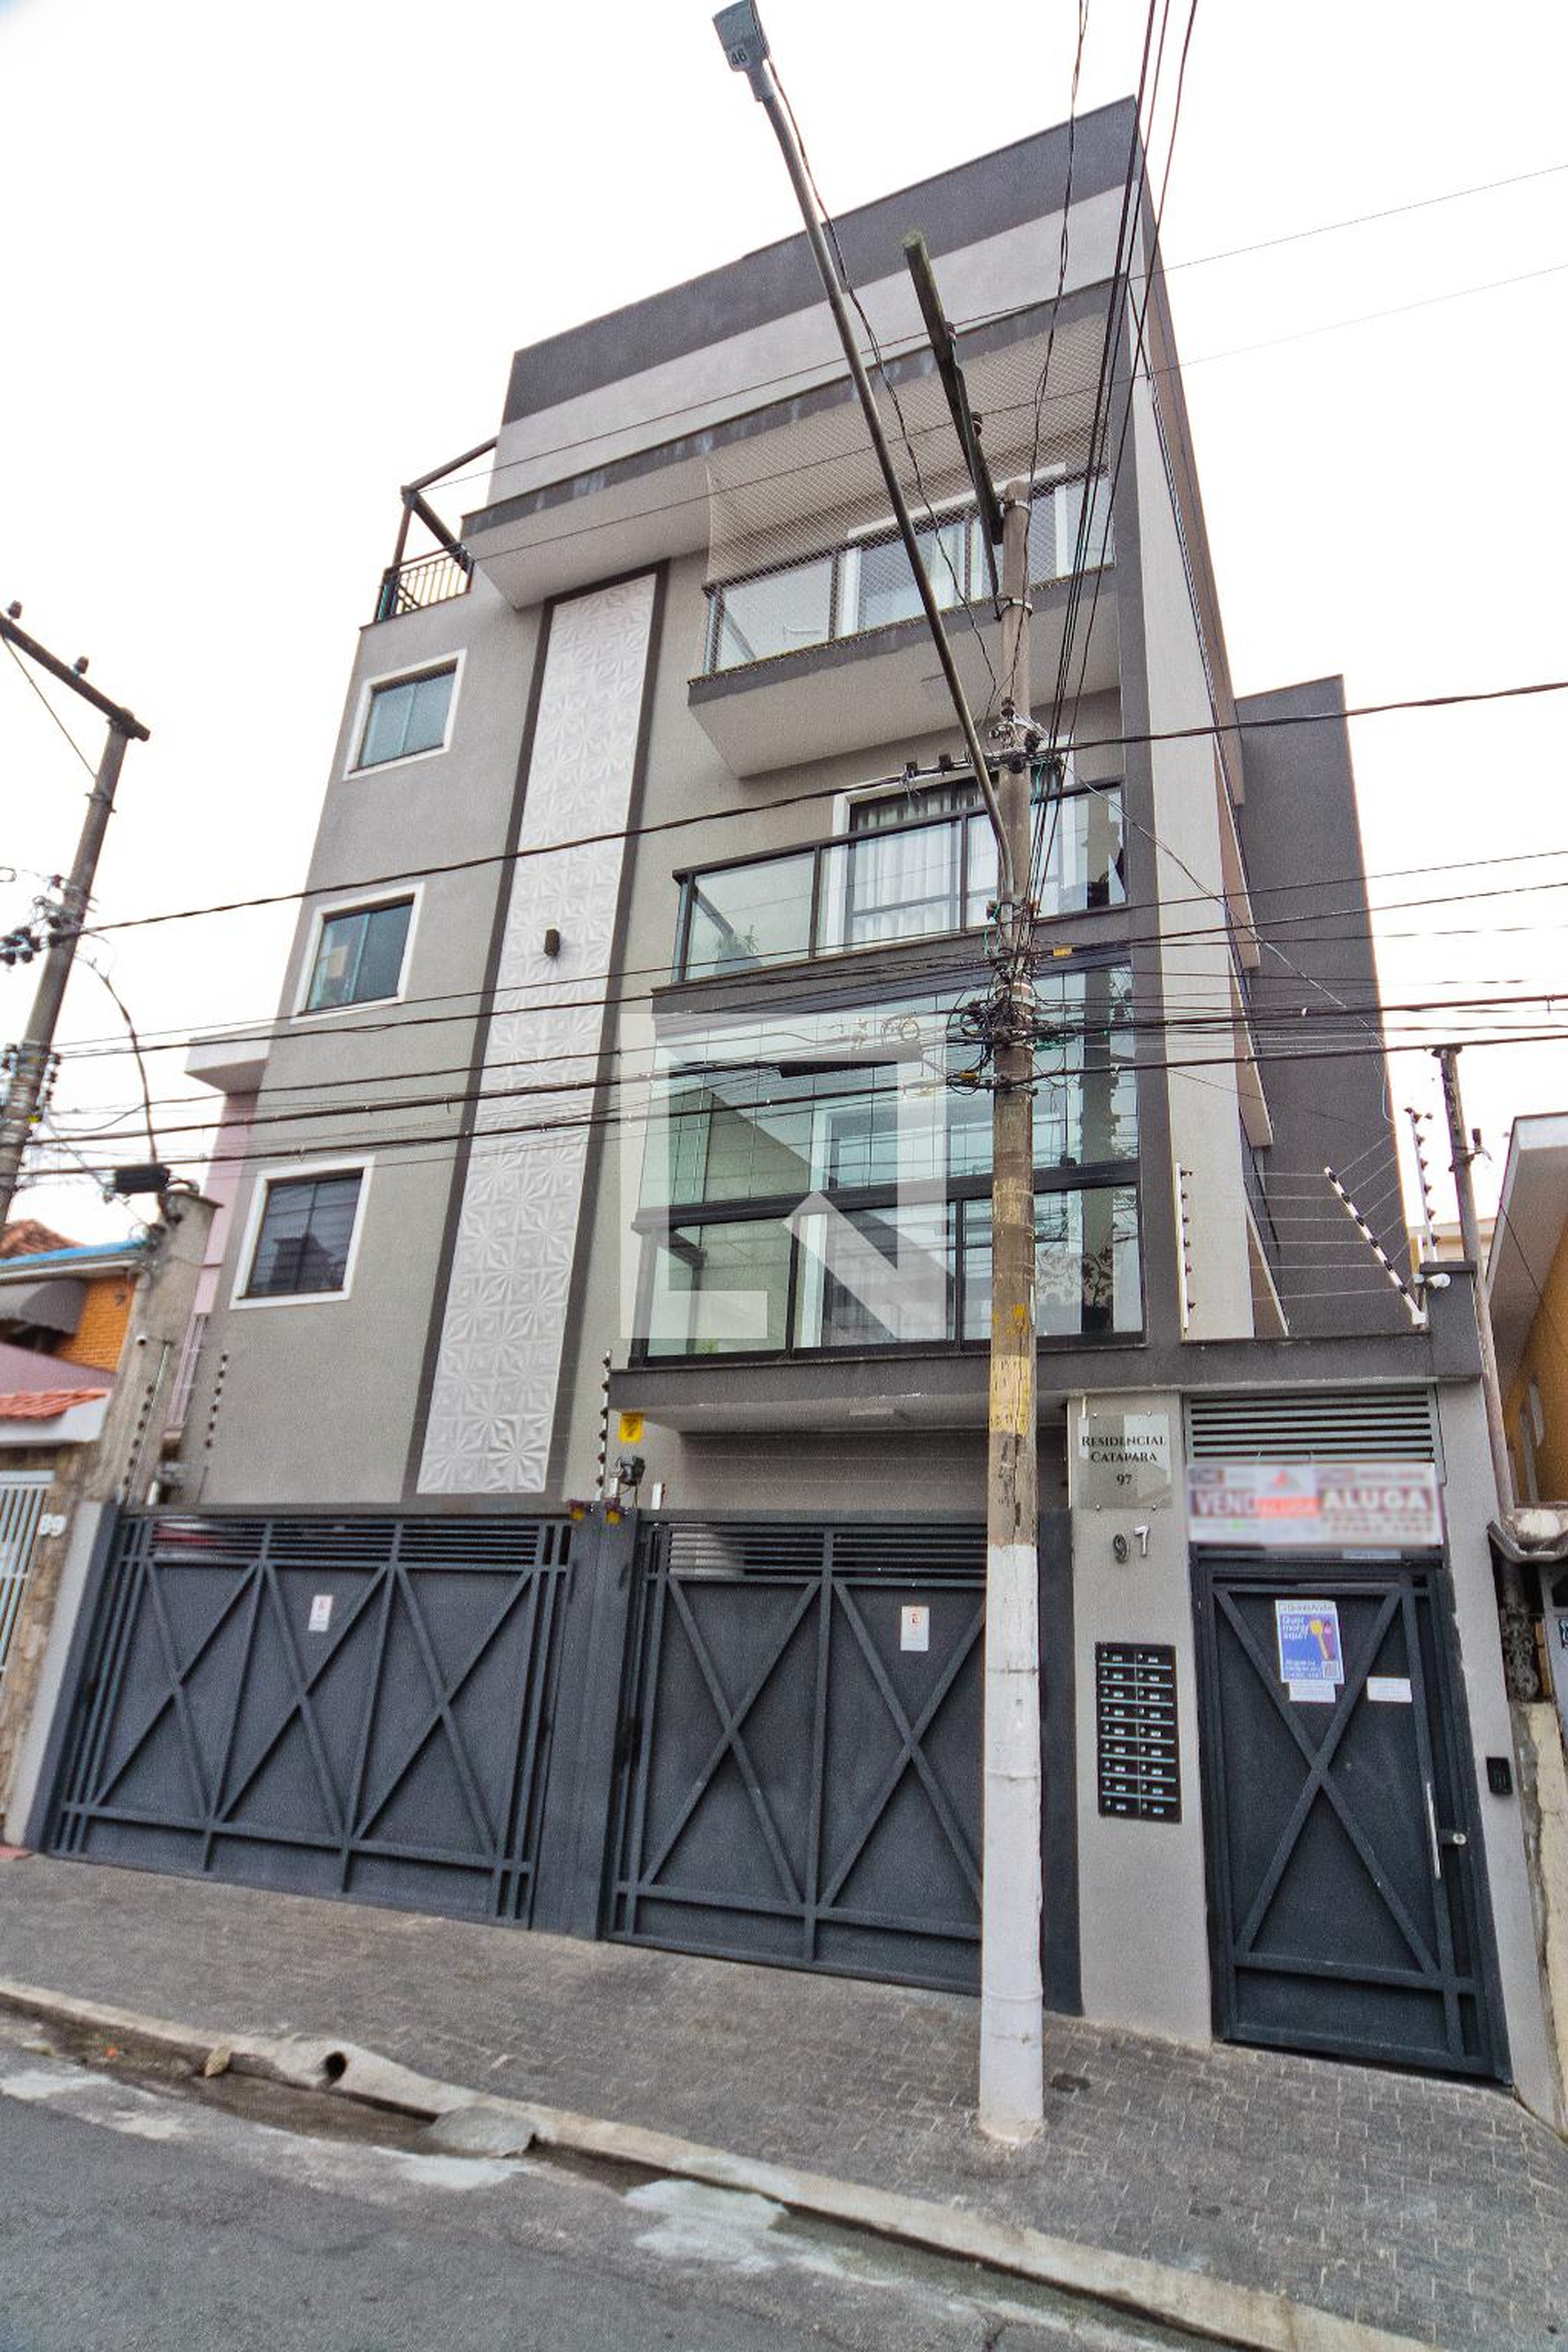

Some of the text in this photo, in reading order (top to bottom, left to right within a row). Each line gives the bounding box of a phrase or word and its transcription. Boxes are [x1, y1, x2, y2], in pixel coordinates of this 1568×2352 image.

[731, 49, 747, 65] 46
[1082, 1436, 1166, 1446] RESIDENCIAL
[1091, 1451, 1157, 1463] CATAPARA
[1117, 1473, 1132, 1486] 97
[1113, 1526, 1149, 1564] 97
